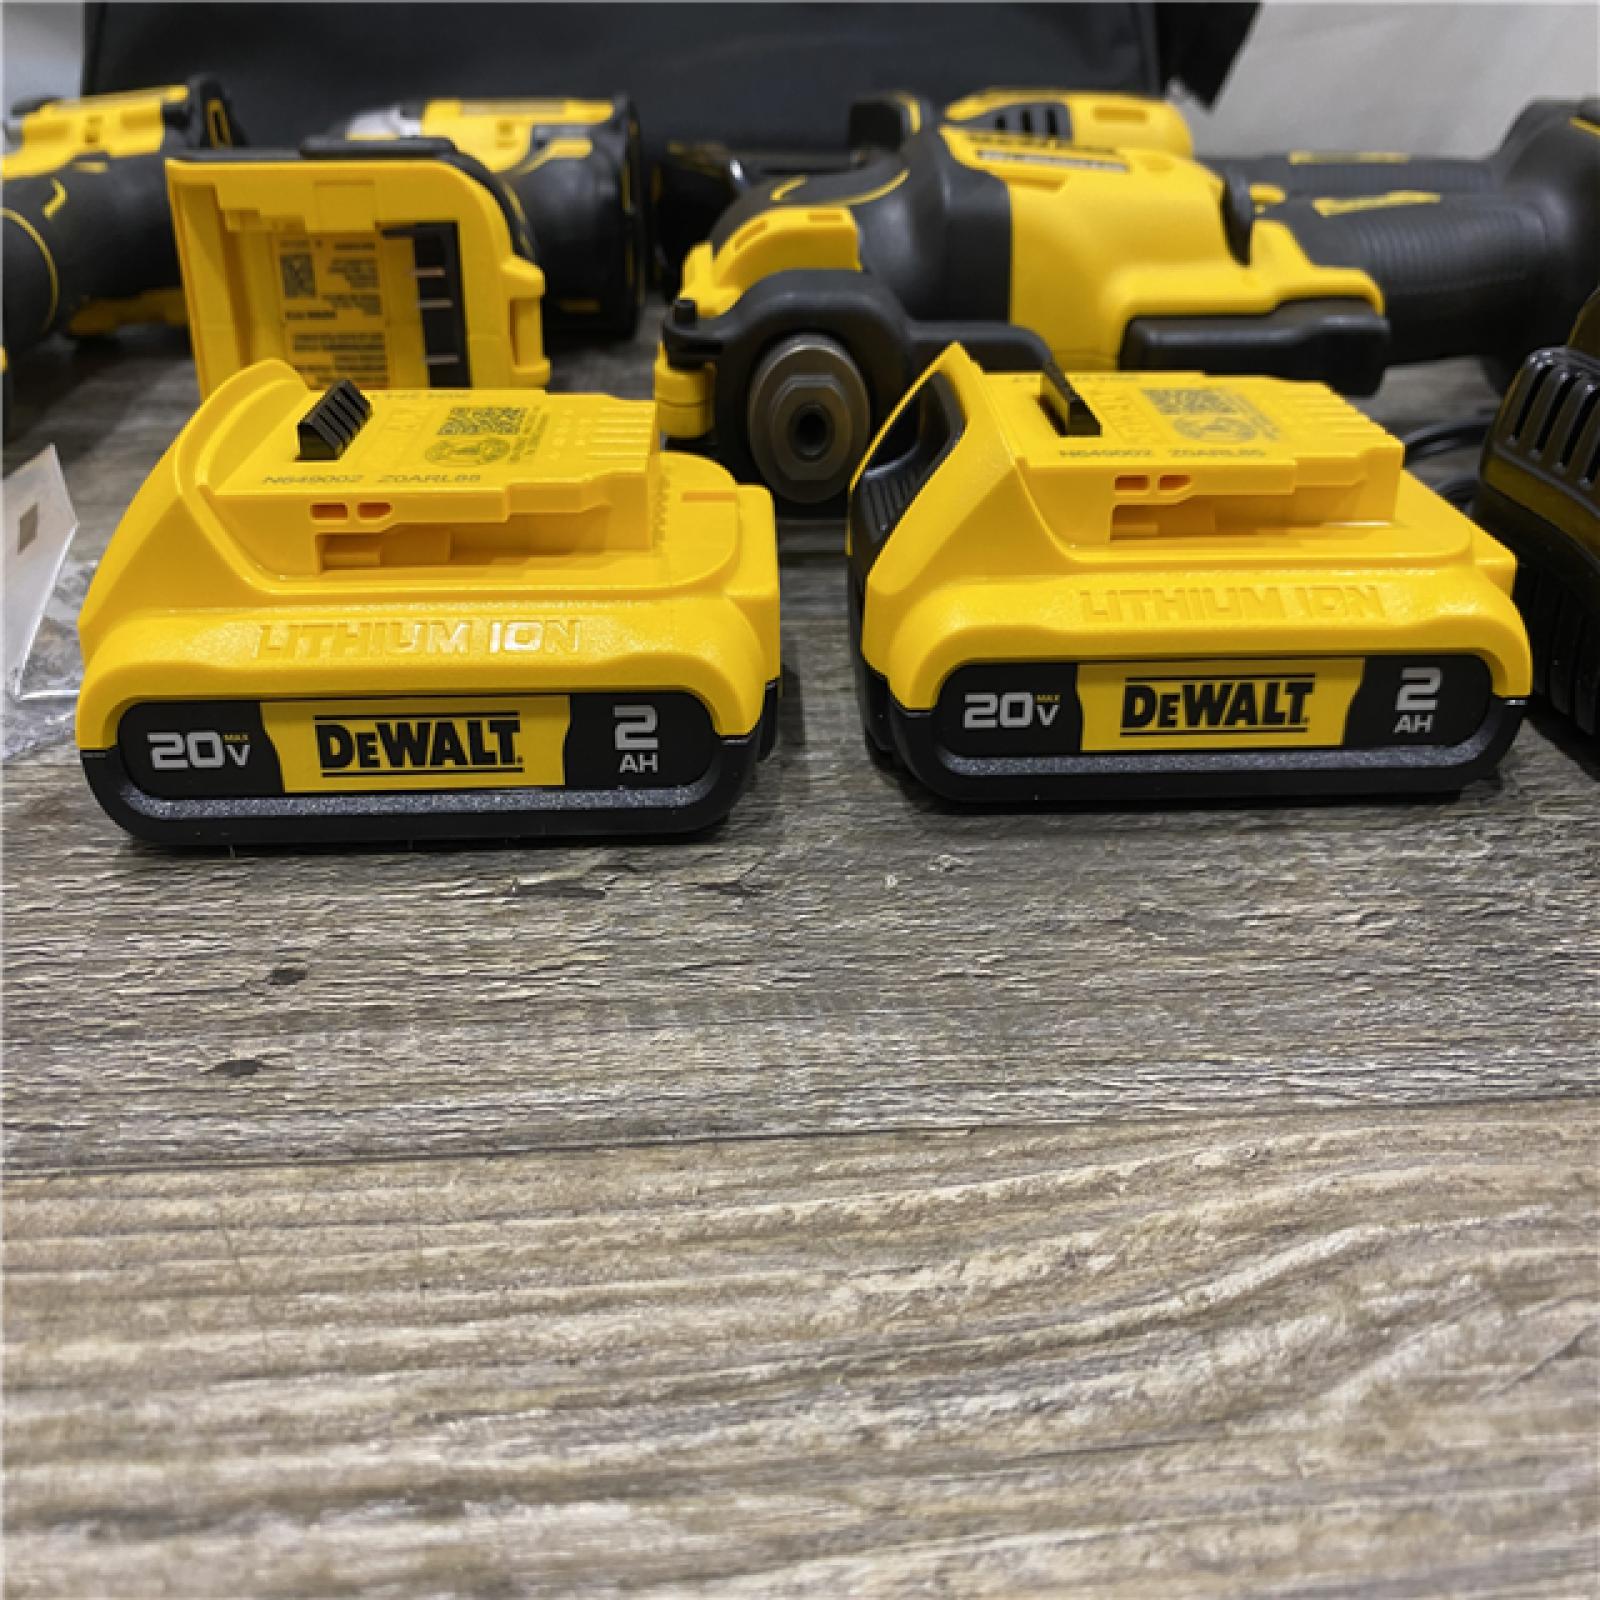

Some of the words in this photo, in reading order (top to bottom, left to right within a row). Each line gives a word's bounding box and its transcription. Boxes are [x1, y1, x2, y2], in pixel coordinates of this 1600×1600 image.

[1079, 587, 1288, 622] LITHIUM
[1293, 585, 1386, 618] ION
[252, 621, 472, 659] LITHIUM
[489, 619, 581, 654] ION
[1121, 681, 1315, 729] DEWALT
[1396, 667, 1442, 711] 2
[314, 718, 521, 769] DEWALT
[614, 704, 658, 750] 2
[1394, 714, 1433, 734] AH
[619, 752, 658, 773] AH
